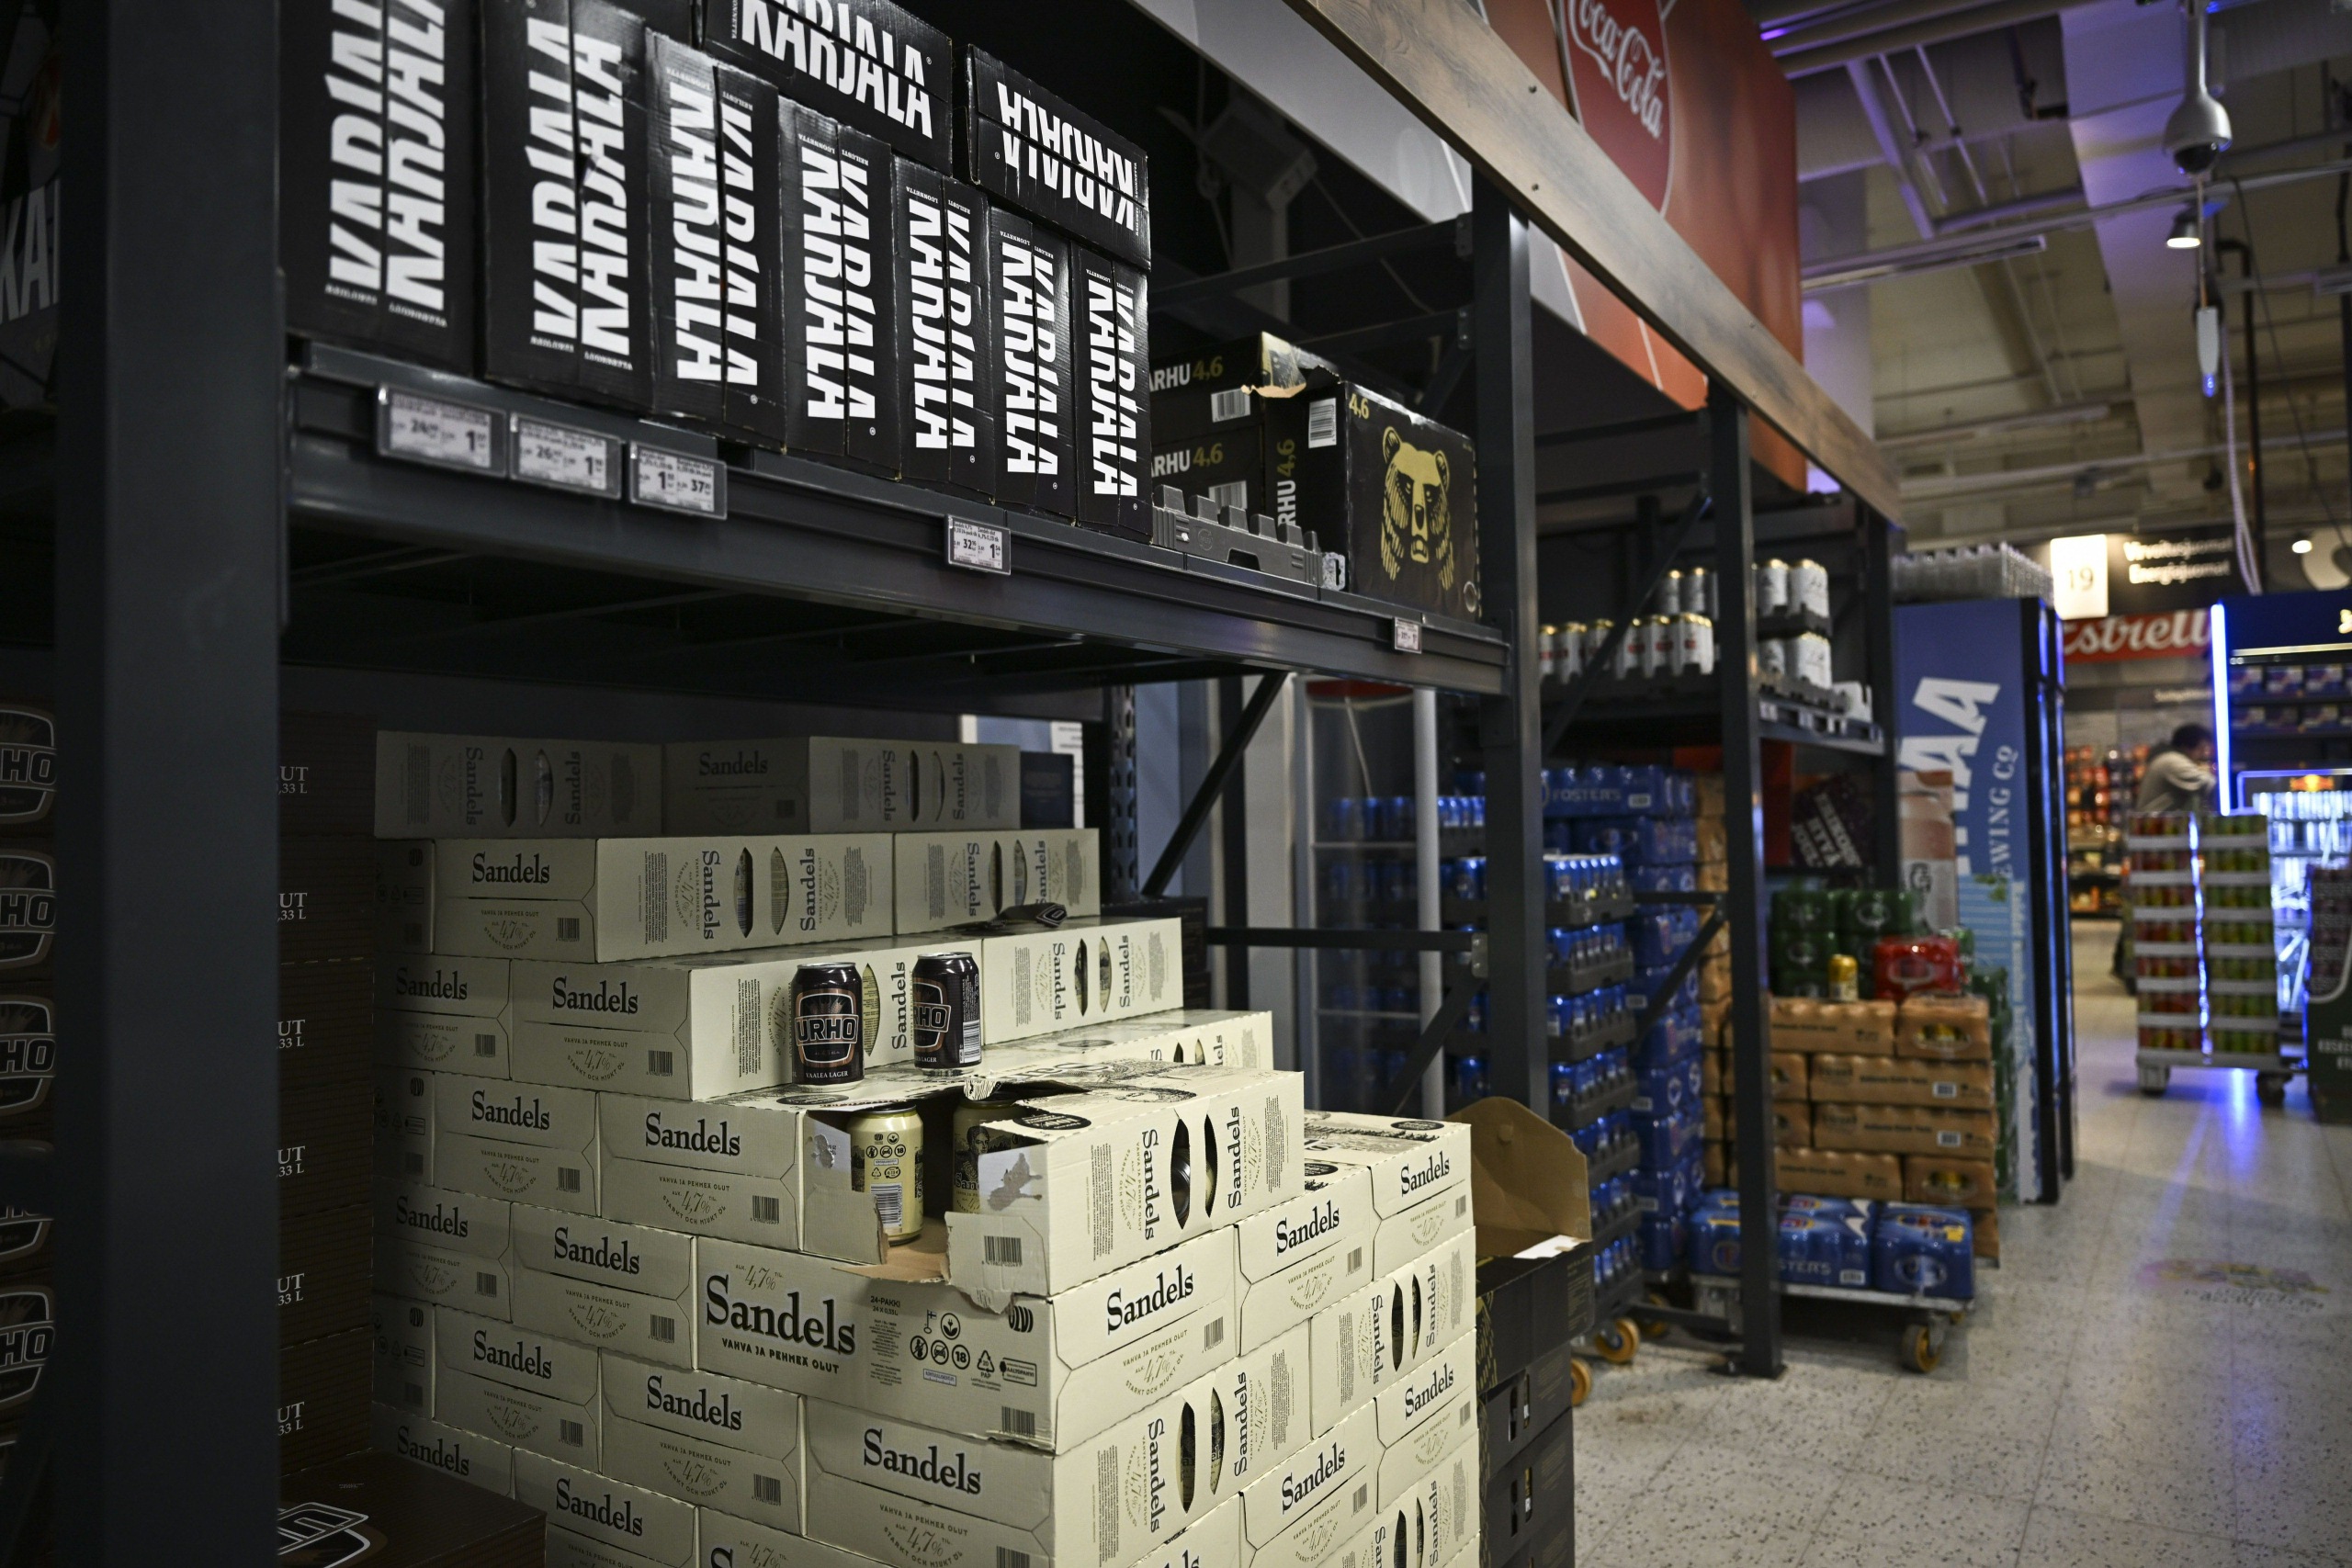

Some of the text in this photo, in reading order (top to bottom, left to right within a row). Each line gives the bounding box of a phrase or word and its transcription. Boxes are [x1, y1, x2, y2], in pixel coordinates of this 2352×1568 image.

[0, 178, 60, 321] KA
[1150, 364, 1191, 391] RHU
[1349, 394, 1370, 420] 4,6
[1151, 449, 1191, 477] RHU
[691, 479, 705, 493] 37
[963, 539, 971, 549] 32
[990, 544, 995, 558] 1
[2069, 567, 2094, 590] 19
[2063, 609, 2212, 655] Estrell
[1, 749, 57, 785] HO
[280, 766, 308, 783] UT
[698, 751, 768, 776] Sandels
[278, 783, 308, 795] ,33 L
[472, 852, 550, 884] Sandels
[967, 841, 981, 917] Sandels
[279, 892, 307, 908] UT
[701, 850, 721, 940] Sandels
[800, 848, 816, 931] Sandels
[0, 895, 56, 929] HO
[277, 909, 307, 922] ,33 L
[396, 967, 468, 1000] Sandels
[1052, 942, 1068, 1021] Sandels
[1119, 934, 1130, 1008] Sandels
[552, 976, 639, 1014] Sandels
[891, 962, 907, 1050] Sandels
[277, 1020, 305, 1037] UT
[796, 1018, 857, 1042] URHO
[914, 1006, 949, 1029] RHO
[0, 1039, 55, 1073] HO
[278, 1037, 305, 1049] 33 L
[471, 1090, 550, 1131] Sandels
[644, 1111, 741, 1156] Sandels
[277, 1146, 305, 1164] UT
[278, 1163, 304, 1177] 33 L
[1227, 1106, 1242, 1209] Sandels
[660, 1176, 677, 1184] VAHVA
[713, 1183, 730, 1191] OLUT
[1142, 1129, 1160, 1240] Sandels
[1400, 1150, 1450, 1197] Sandels
[396, 1196, 469, 1237] Sandels
[682, 1191, 710, 1214] 4,7%
[685, 1216, 698, 1224] OCH
[1275, 1200, 1340, 1257] Sandels
[554, 1226, 639, 1275] Sandels
[1780, 1259, 1831, 1276] STERS
[277, 1273, 304, 1293] UT
[745, 1265, 776, 1291] 4,7%
[278, 1291, 304, 1305] 33 L
[707, 1274, 855, 1355] Sandels
[870, 1295, 900, 1308] 24-PAKKI
[1106, 1263, 1194, 1336] Sandels
[1426, 1262, 1436, 1348] Sandels
[0, 1325, 54, 1365] HO
[473, 1329, 552, 1379] Sandels
[722, 1337, 839, 1374] VAHVA JA PEHMEÄ OLUT
[956, 1351, 967, 1363] 18
[1123, 1352, 1141, 1367] VAHVA
[1173, 1329, 1188, 1340] OLUT
[1371, 1294, 1385, 1386] Sandels
[647, 1375, 742, 1431] Sandels
[1404, 1362, 1454, 1421] Sandels
[277, 1402, 304, 1423] UT
[278, 1420, 304, 1436] 33 L
[1234, 1371, 1249, 1477] Sandels
[397, 1426, 469, 1476] Sandels
[864, 1427, 981, 1495] Sandels
[1148, 1418, 1166, 1533] Sandels
[1281, 1441, 1346, 1515] Sandels
[556, 1477, 643, 1537] Sandels
[879, 1504, 968, 1536] VAHVA JA PEHMEÄ OLUT
[884, 1527, 909, 1556] STARKT
[911, 1554, 927, 1566] OCH
[907, 1527, 944, 1557] 4,7%
